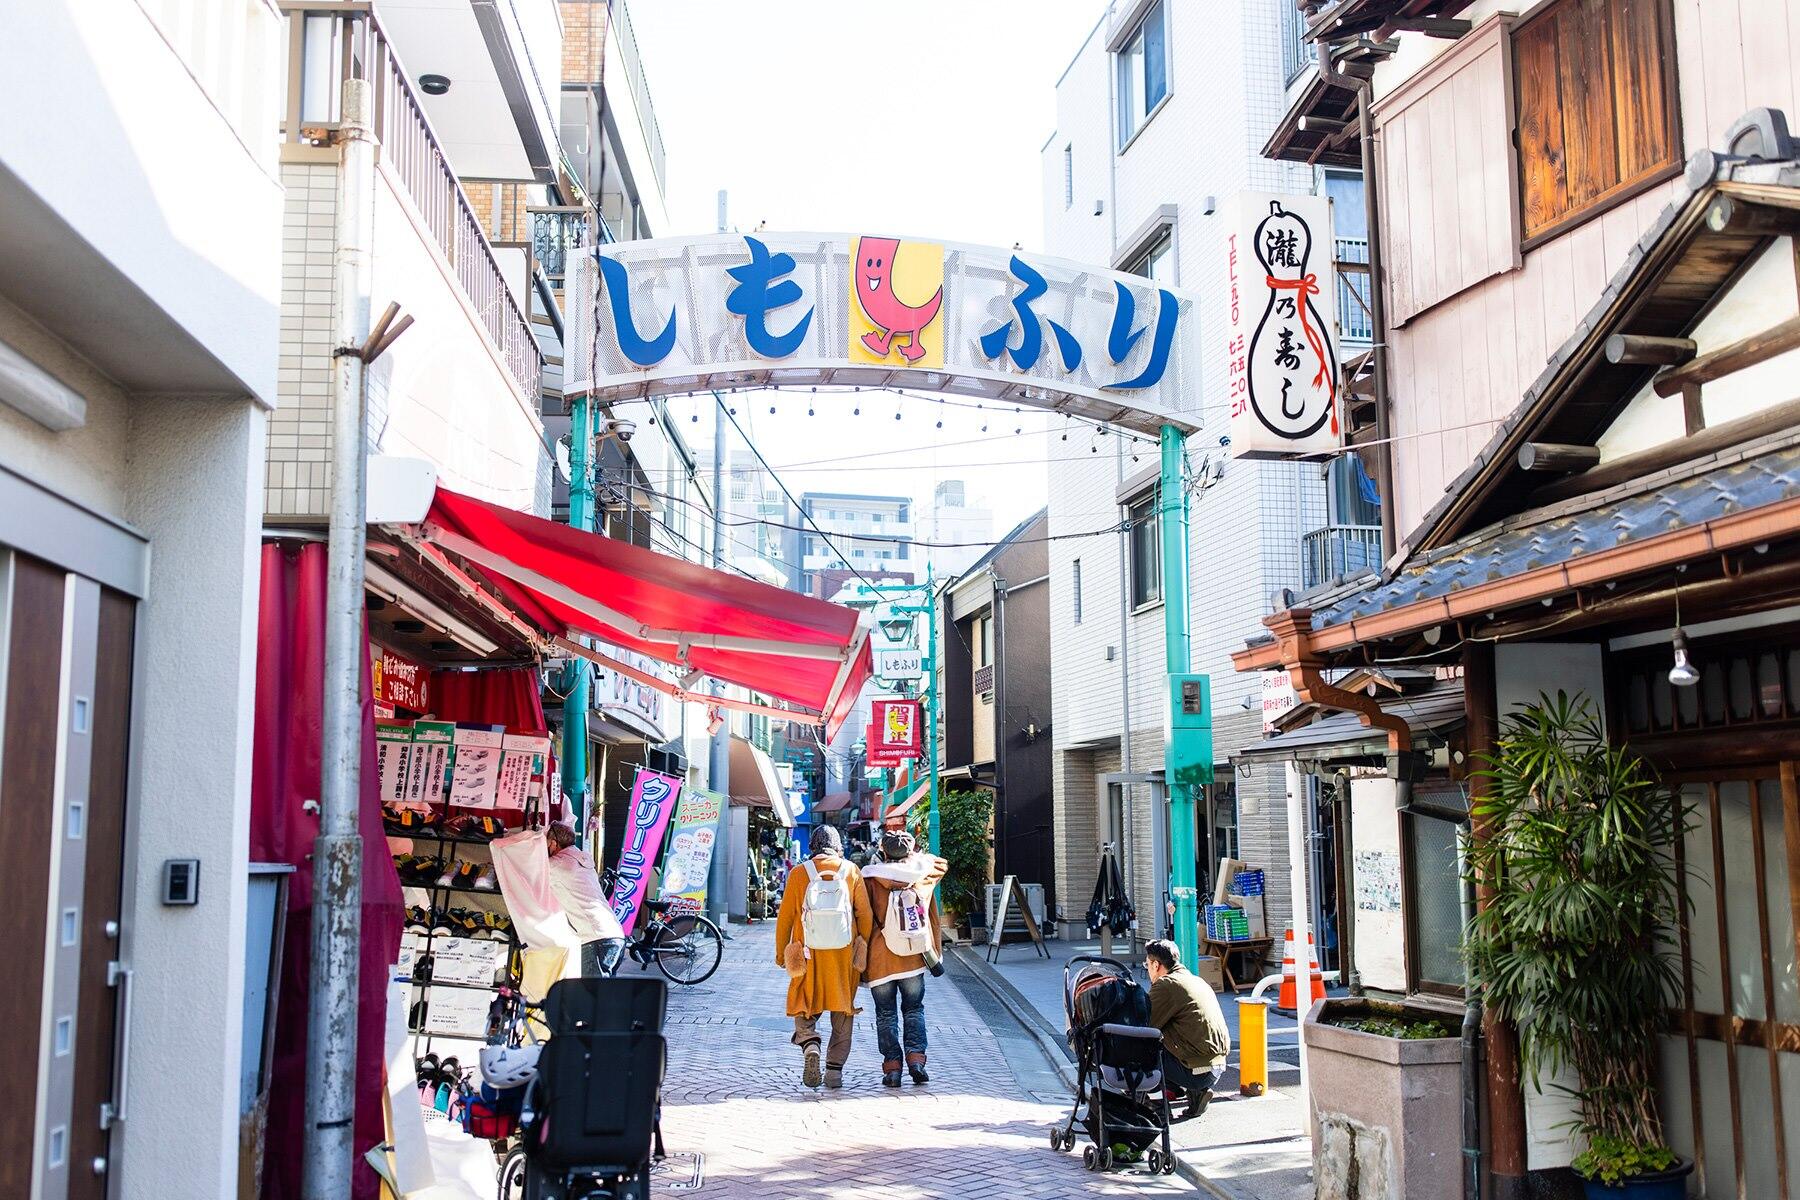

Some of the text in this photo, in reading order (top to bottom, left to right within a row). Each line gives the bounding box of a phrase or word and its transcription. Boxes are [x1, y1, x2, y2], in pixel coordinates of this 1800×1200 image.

[885, 659, 918, 671] しもふり
[681, 801, 719, 813] スニーカー
[680, 810, 719, 824] クリーニング
[614, 777, 672, 926] クリーニング
